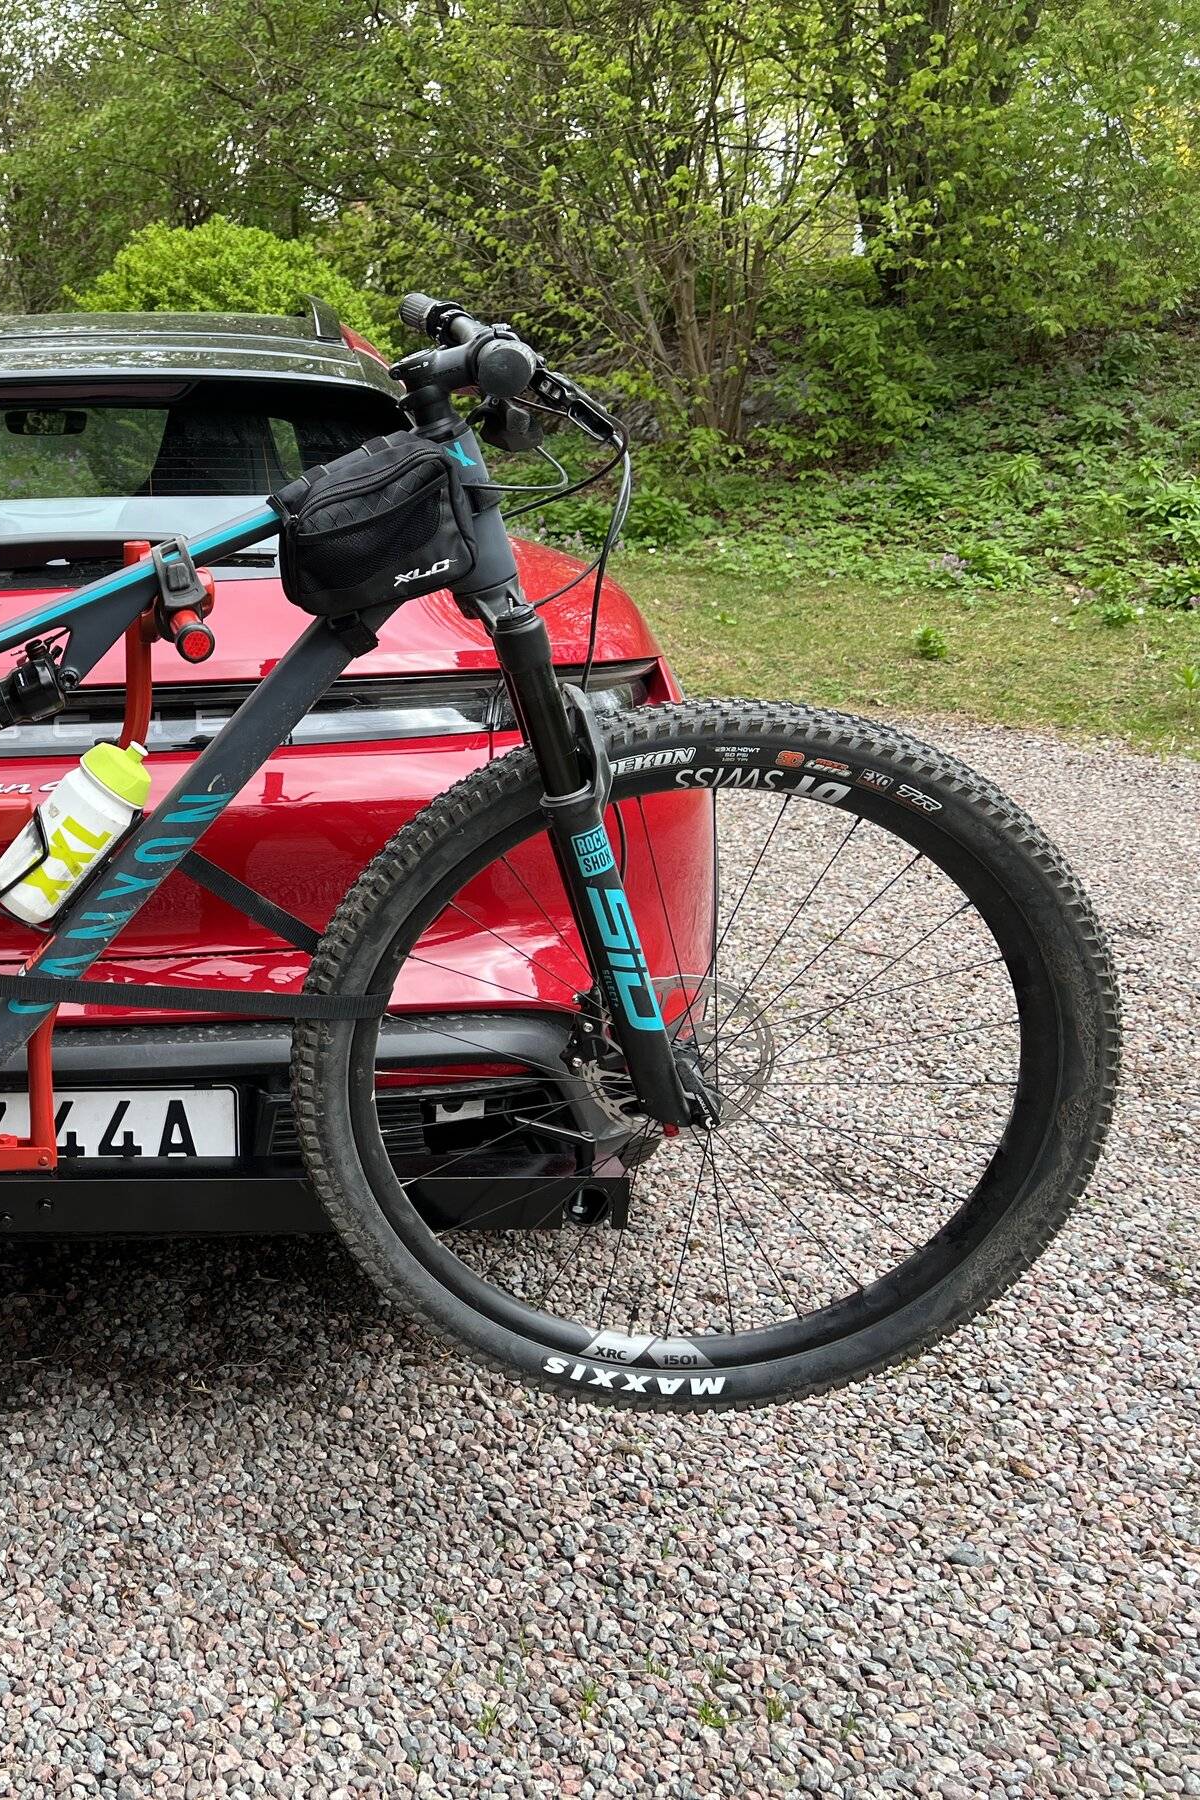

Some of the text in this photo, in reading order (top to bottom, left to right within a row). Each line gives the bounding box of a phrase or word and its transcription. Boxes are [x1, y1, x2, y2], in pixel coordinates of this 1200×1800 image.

[672, 767, 784, 791] SWISS
[781, 774, 851, 804] DT
[862, 769, 892, 787] EXO
[896, 784, 942, 811] TR
[576, 828, 608, 855] ROCK
[20, 815, 114, 907] XXL
[586, 886, 665, 1031] SID
[594, 1345, 698, 1366] XRC 1501
[543, 1356, 727, 1396] MAXXIS
